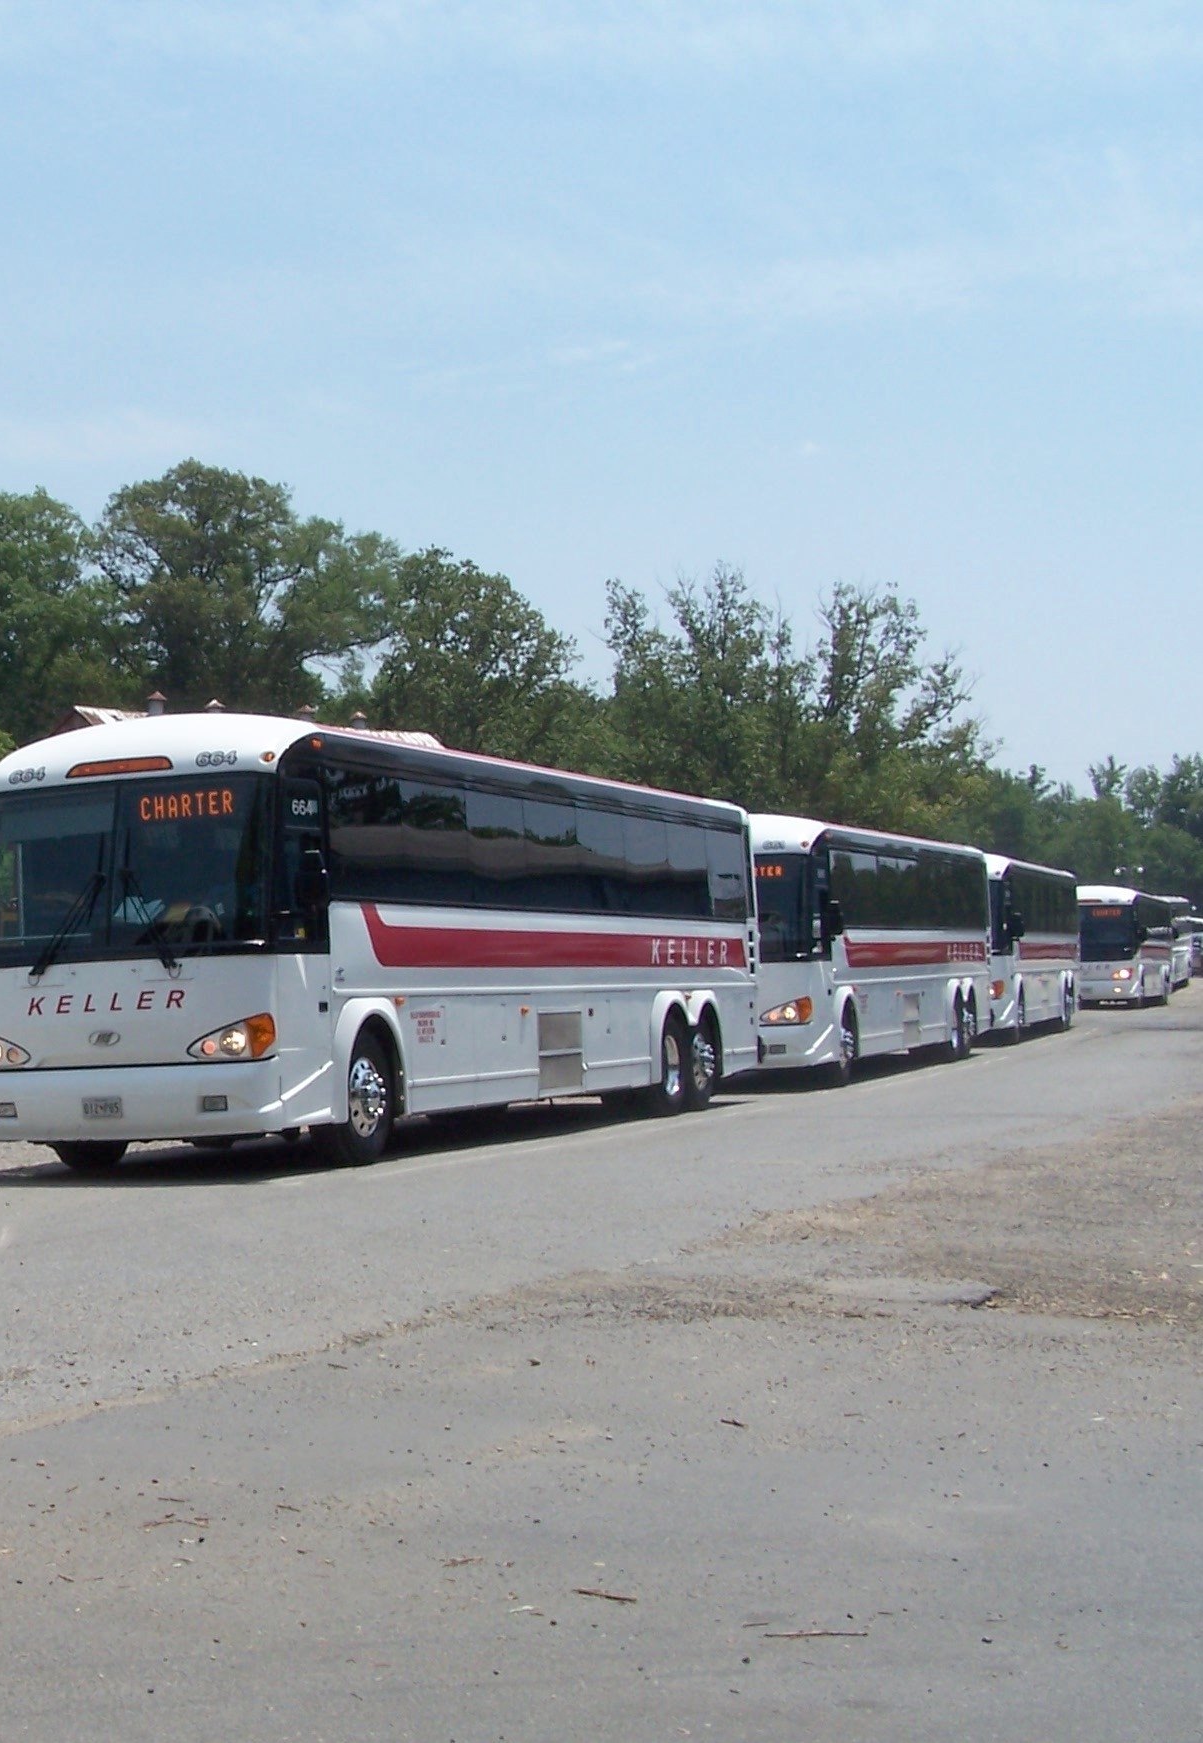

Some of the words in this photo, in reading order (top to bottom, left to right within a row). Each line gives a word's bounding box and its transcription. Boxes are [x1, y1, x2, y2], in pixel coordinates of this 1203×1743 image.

[195, 750, 238, 767] 664
[8, 766, 46, 785] 664
[139, 788, 234, 821] CHARTER
[651, 938, 728, 965] KELLER
[27, 989, 188, 1016] KELLER
